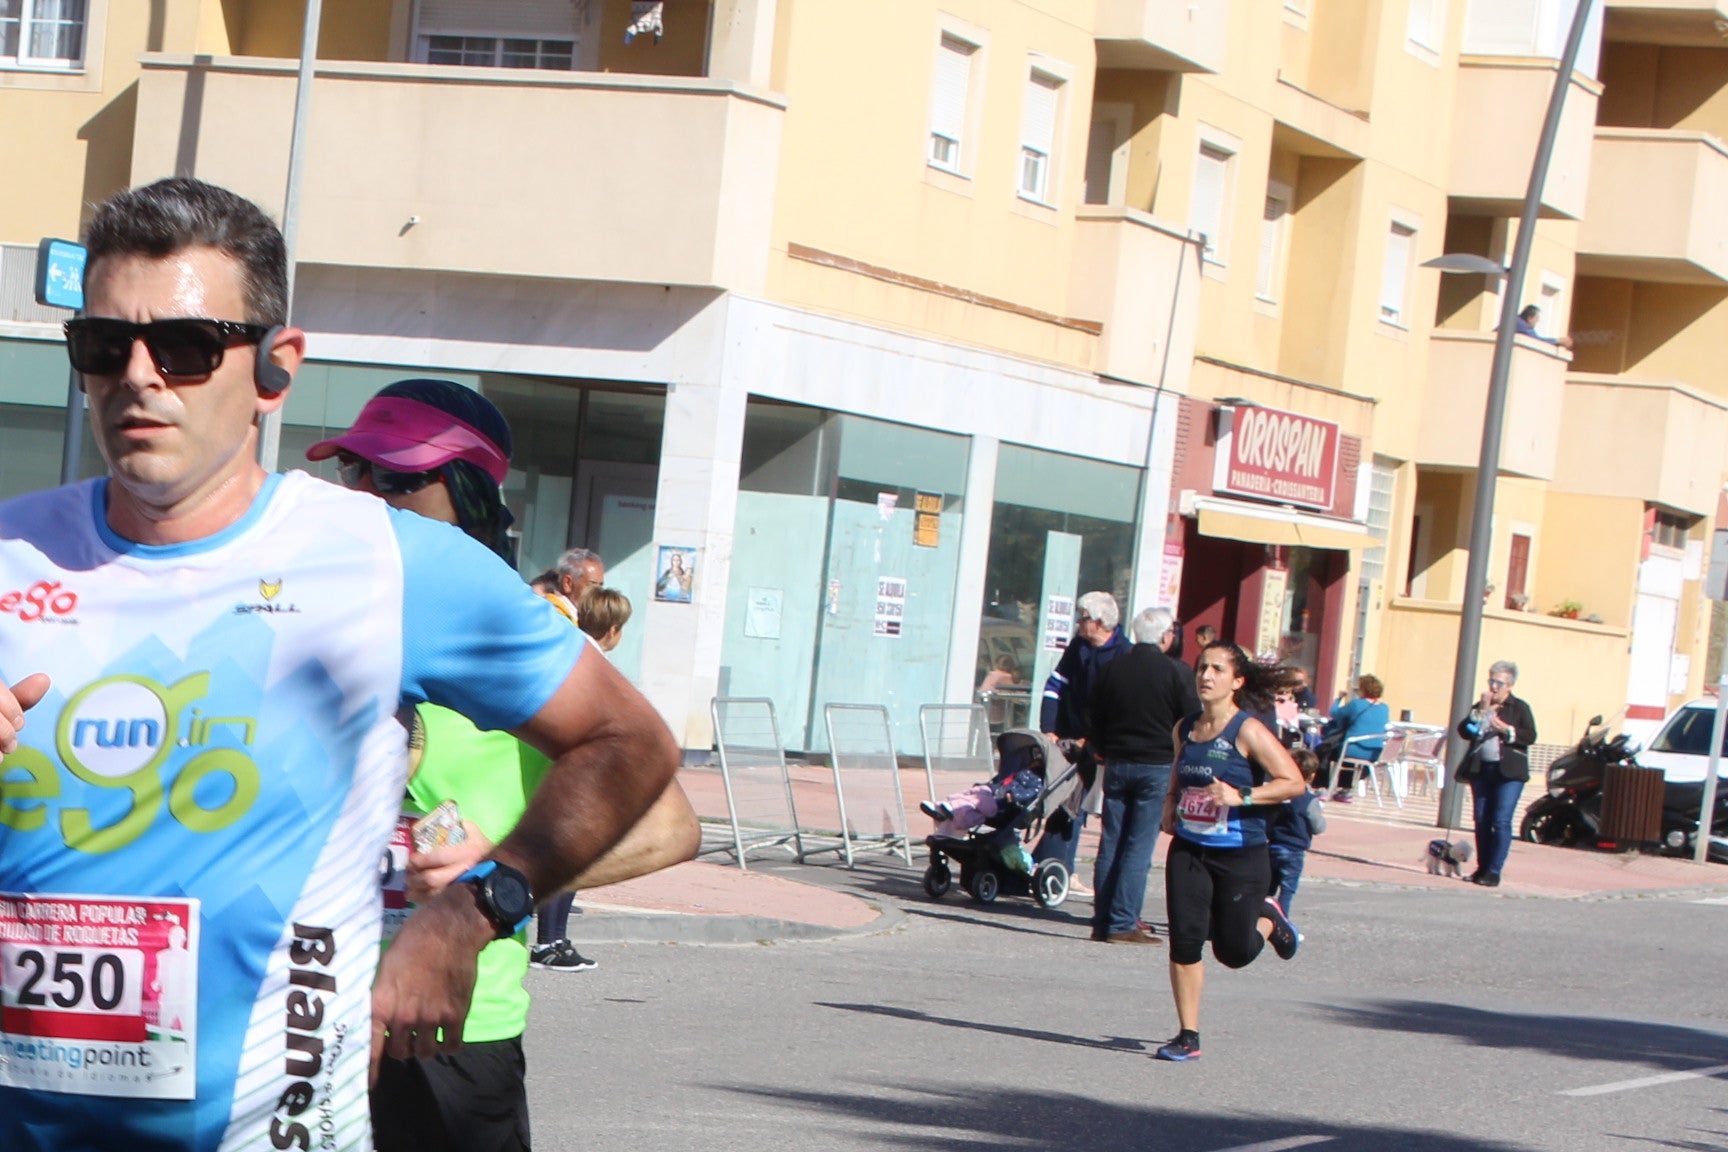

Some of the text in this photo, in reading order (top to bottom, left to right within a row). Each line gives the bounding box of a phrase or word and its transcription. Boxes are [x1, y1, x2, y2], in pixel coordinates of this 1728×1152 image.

[1237, 408, 1327, 479] OROSPAN
[73, 716, 160, 748] run
[20, 901, 78, 922] CARRERA
[79, 903, 148, 925] POPULAR
[44, 923, 62, 943] DE
[64, 924, 139, 946] ROQUETAS
[16, 949, 125, 1010] 250
[270, 921, 337, 1152] Blanes
